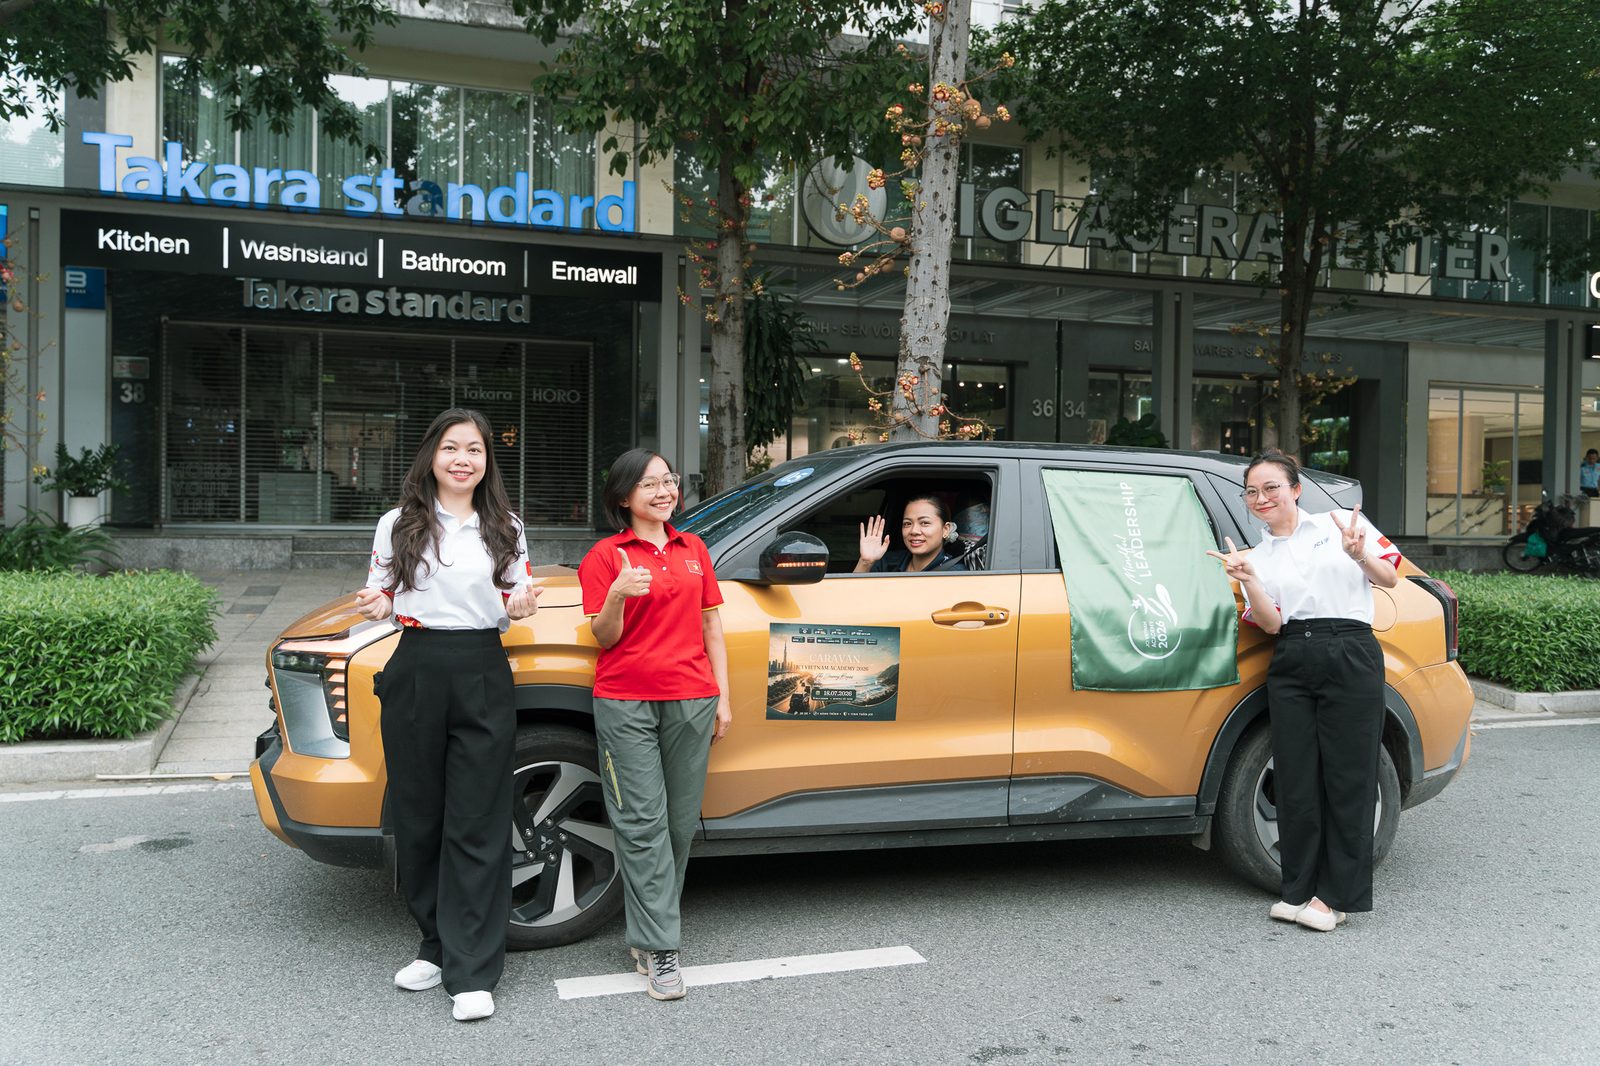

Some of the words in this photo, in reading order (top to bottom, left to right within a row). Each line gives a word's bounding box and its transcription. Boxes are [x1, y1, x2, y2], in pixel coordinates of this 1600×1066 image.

[82, 131, 321, 212] Takara
[343, 167, 636, 234] standard
[97, 228, 190, 256] Kitchen
[903, 178, 1286, 263] IGLACERA
[1304, 211, 1510, 282] ENTER
[240, 238, 369, 267] Washstand
[401, 250, 507, 277] Bathroom
[551, 261, 638, 286] Emawall
[236, 276, 360, 314] Takara
[365, 286, 532, 324] standard
[841, 323, 868, 337] SEN
[119, 382, 146, 404] 38
[462, 385, 513, 401] Takara
[532, 387, 581, 404] HORO
[1032, 399, 1054, 417] 36
[1064, 400, 1086, 418] 34
[1120, 481, 1153, 578] LEADERSHIP
[1113, 534, 1142, 585] Mindful
[1155, 620, 1168, 649] 2026
[809, 654, 861, 664] CARAVAN
